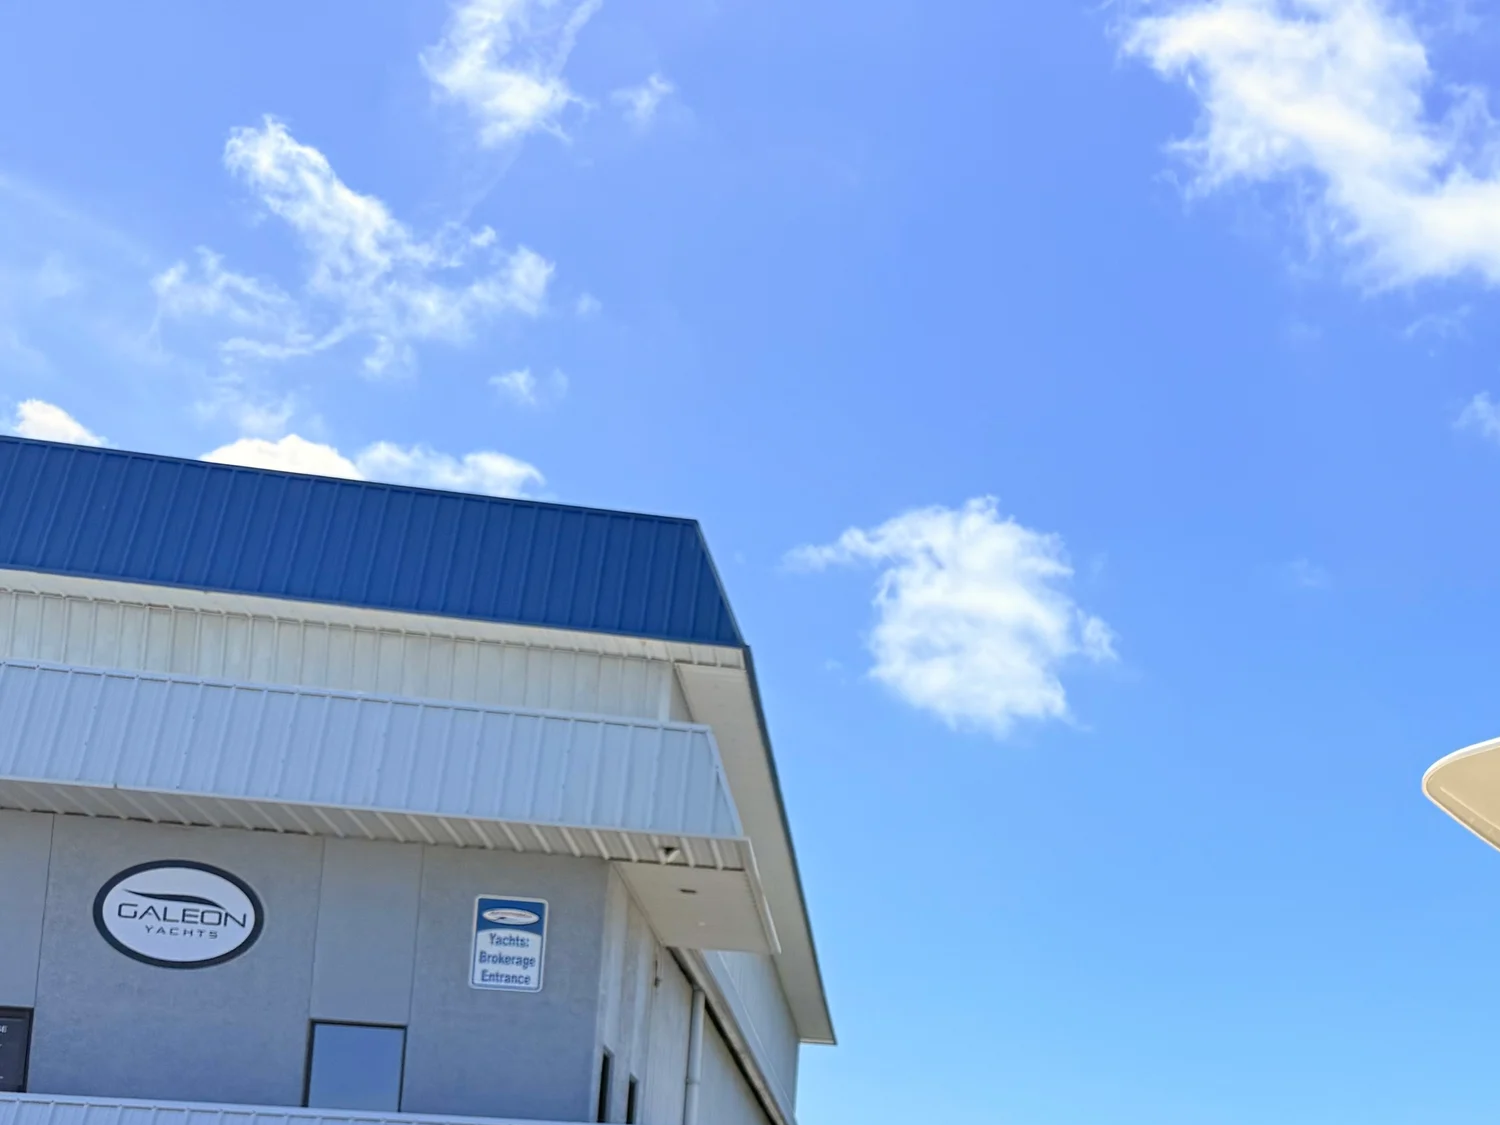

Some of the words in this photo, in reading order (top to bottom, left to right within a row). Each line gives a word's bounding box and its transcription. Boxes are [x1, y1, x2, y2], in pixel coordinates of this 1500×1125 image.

[117, 903, 247, 928] GALEON
[145, 925, 218, 939] YACHTS
[479, 950, 536, 969] Brokerage
[481, 969, 531, 985] Entrance
